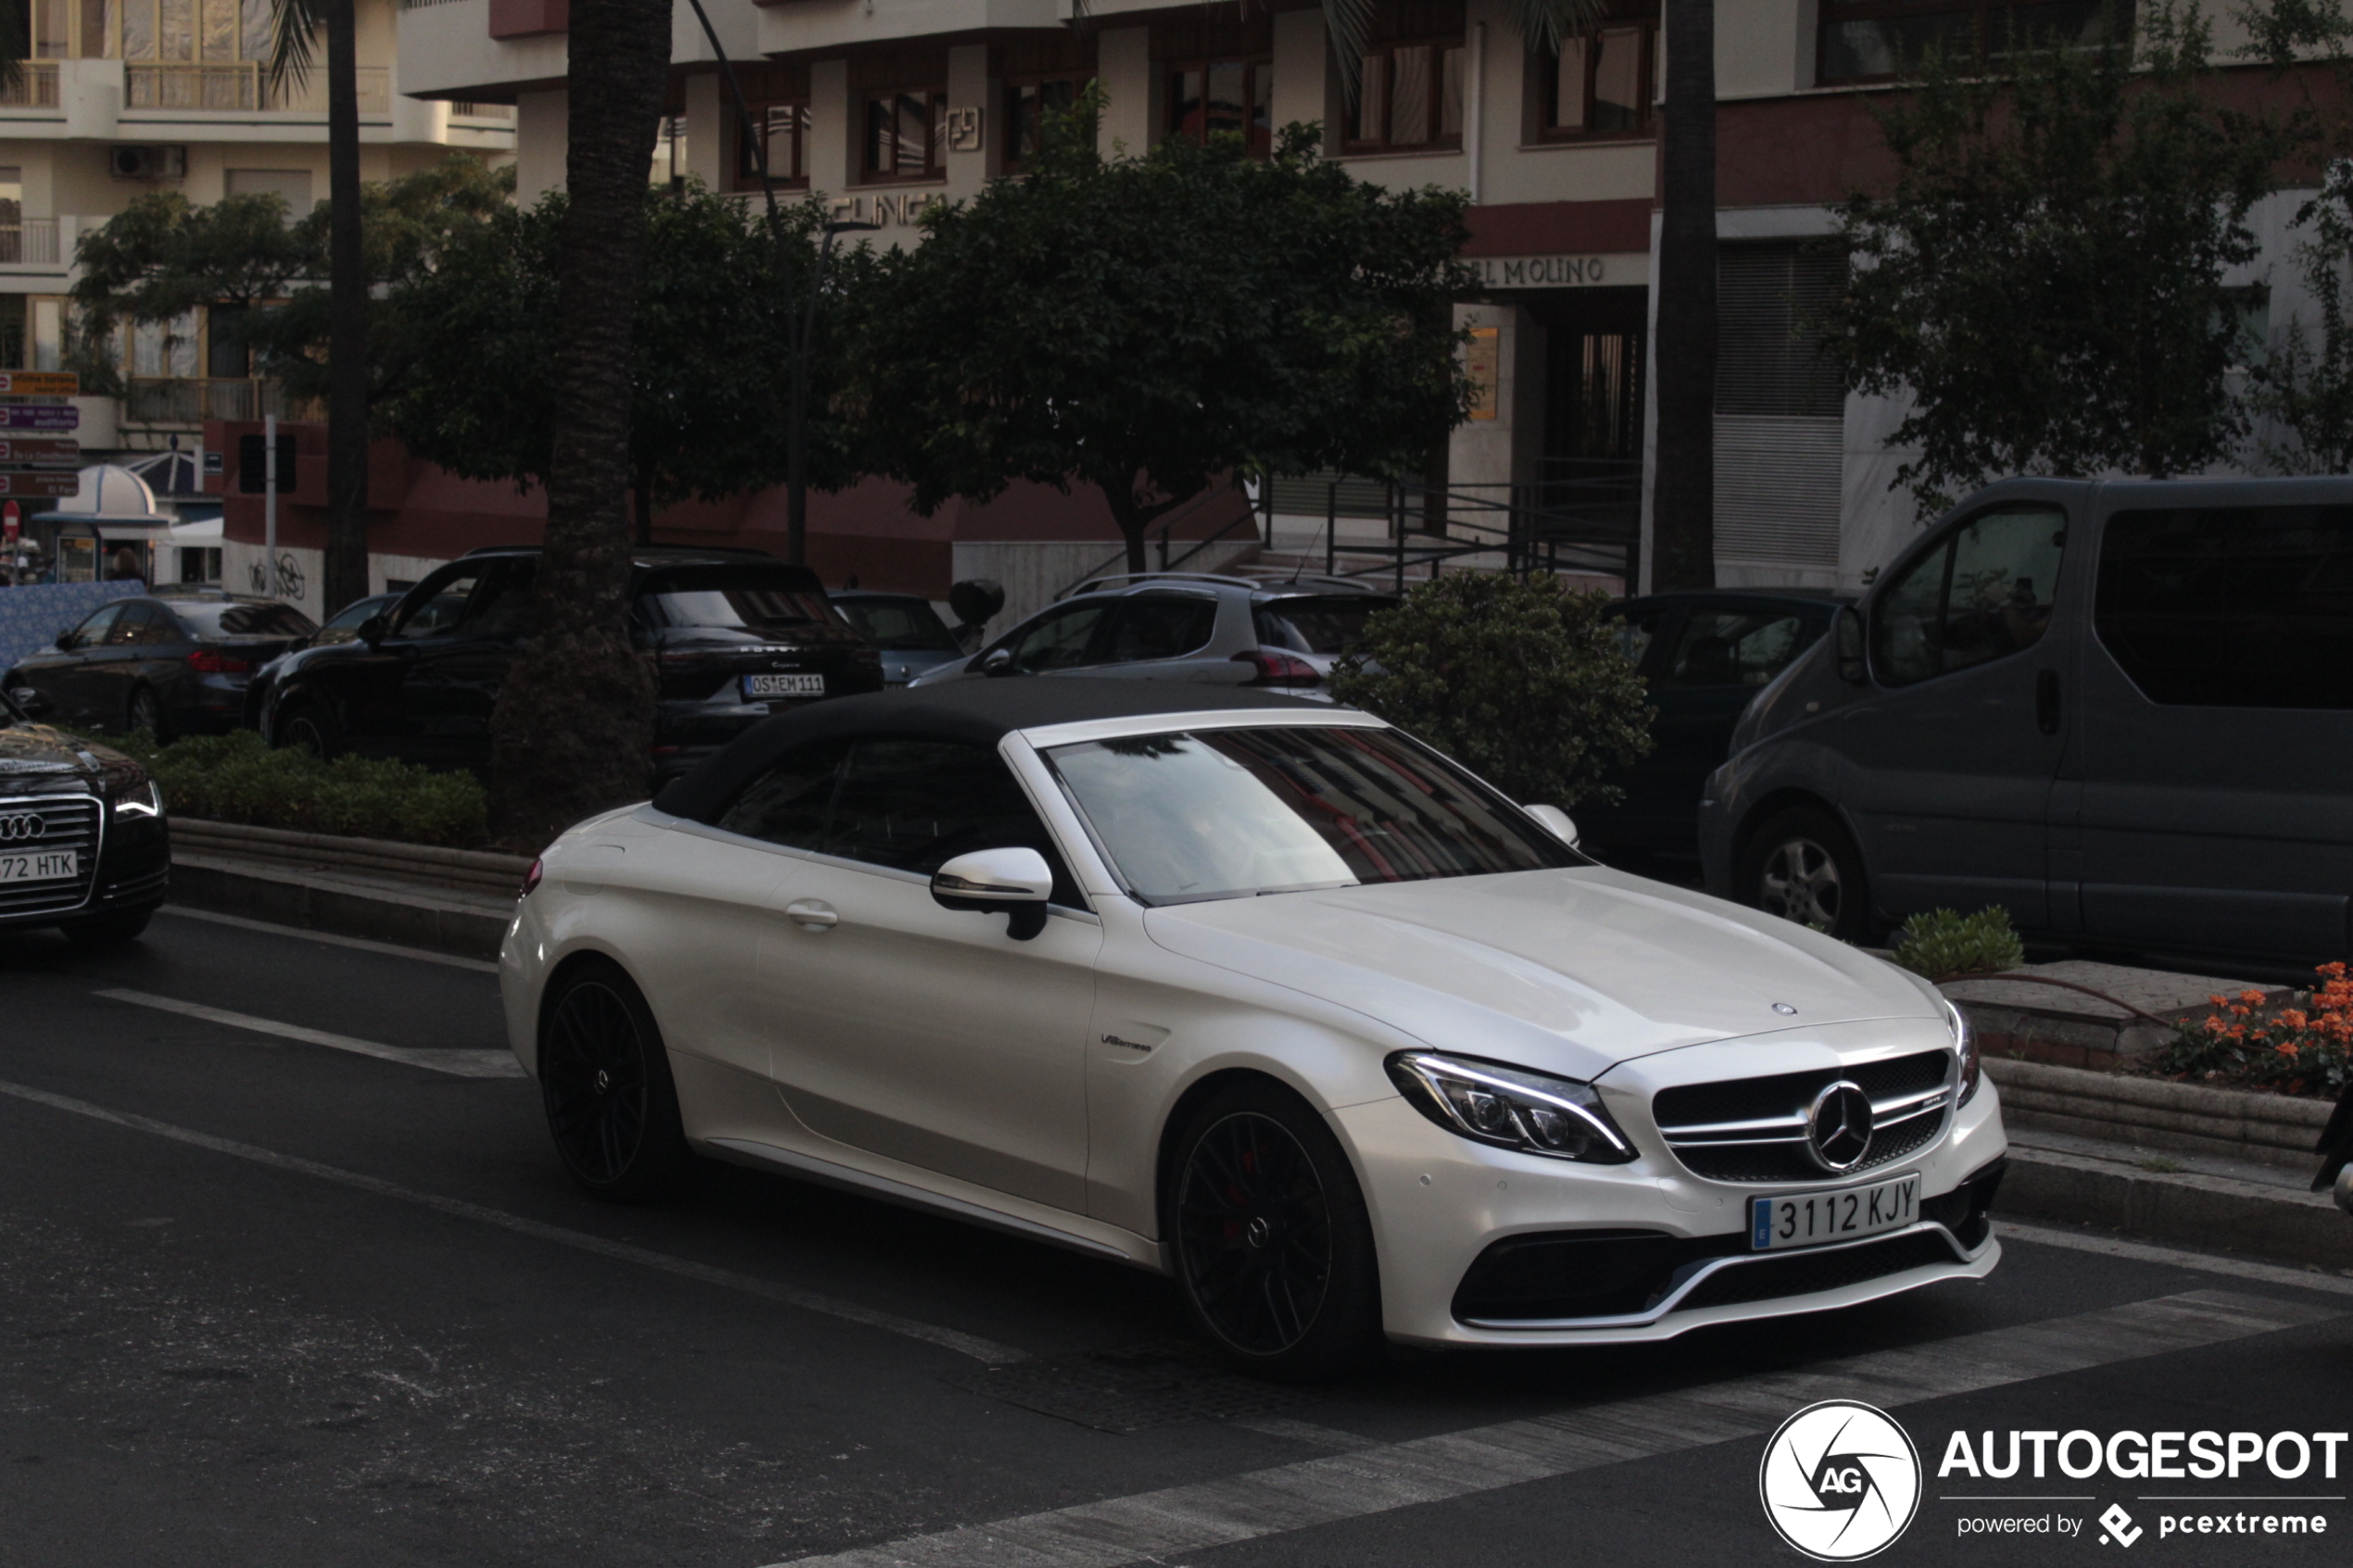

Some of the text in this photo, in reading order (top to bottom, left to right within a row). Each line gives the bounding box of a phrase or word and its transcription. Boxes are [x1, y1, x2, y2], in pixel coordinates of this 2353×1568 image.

[1504, 258, 1603, 284] MOLINO
[752, 677, 823, 692] OS EM 111
[0, 854, 73, 879] 72 HTK
[1779, 1194, 1858, 1239] 3112
[1868, 1180, 1915, 1227] KJY
